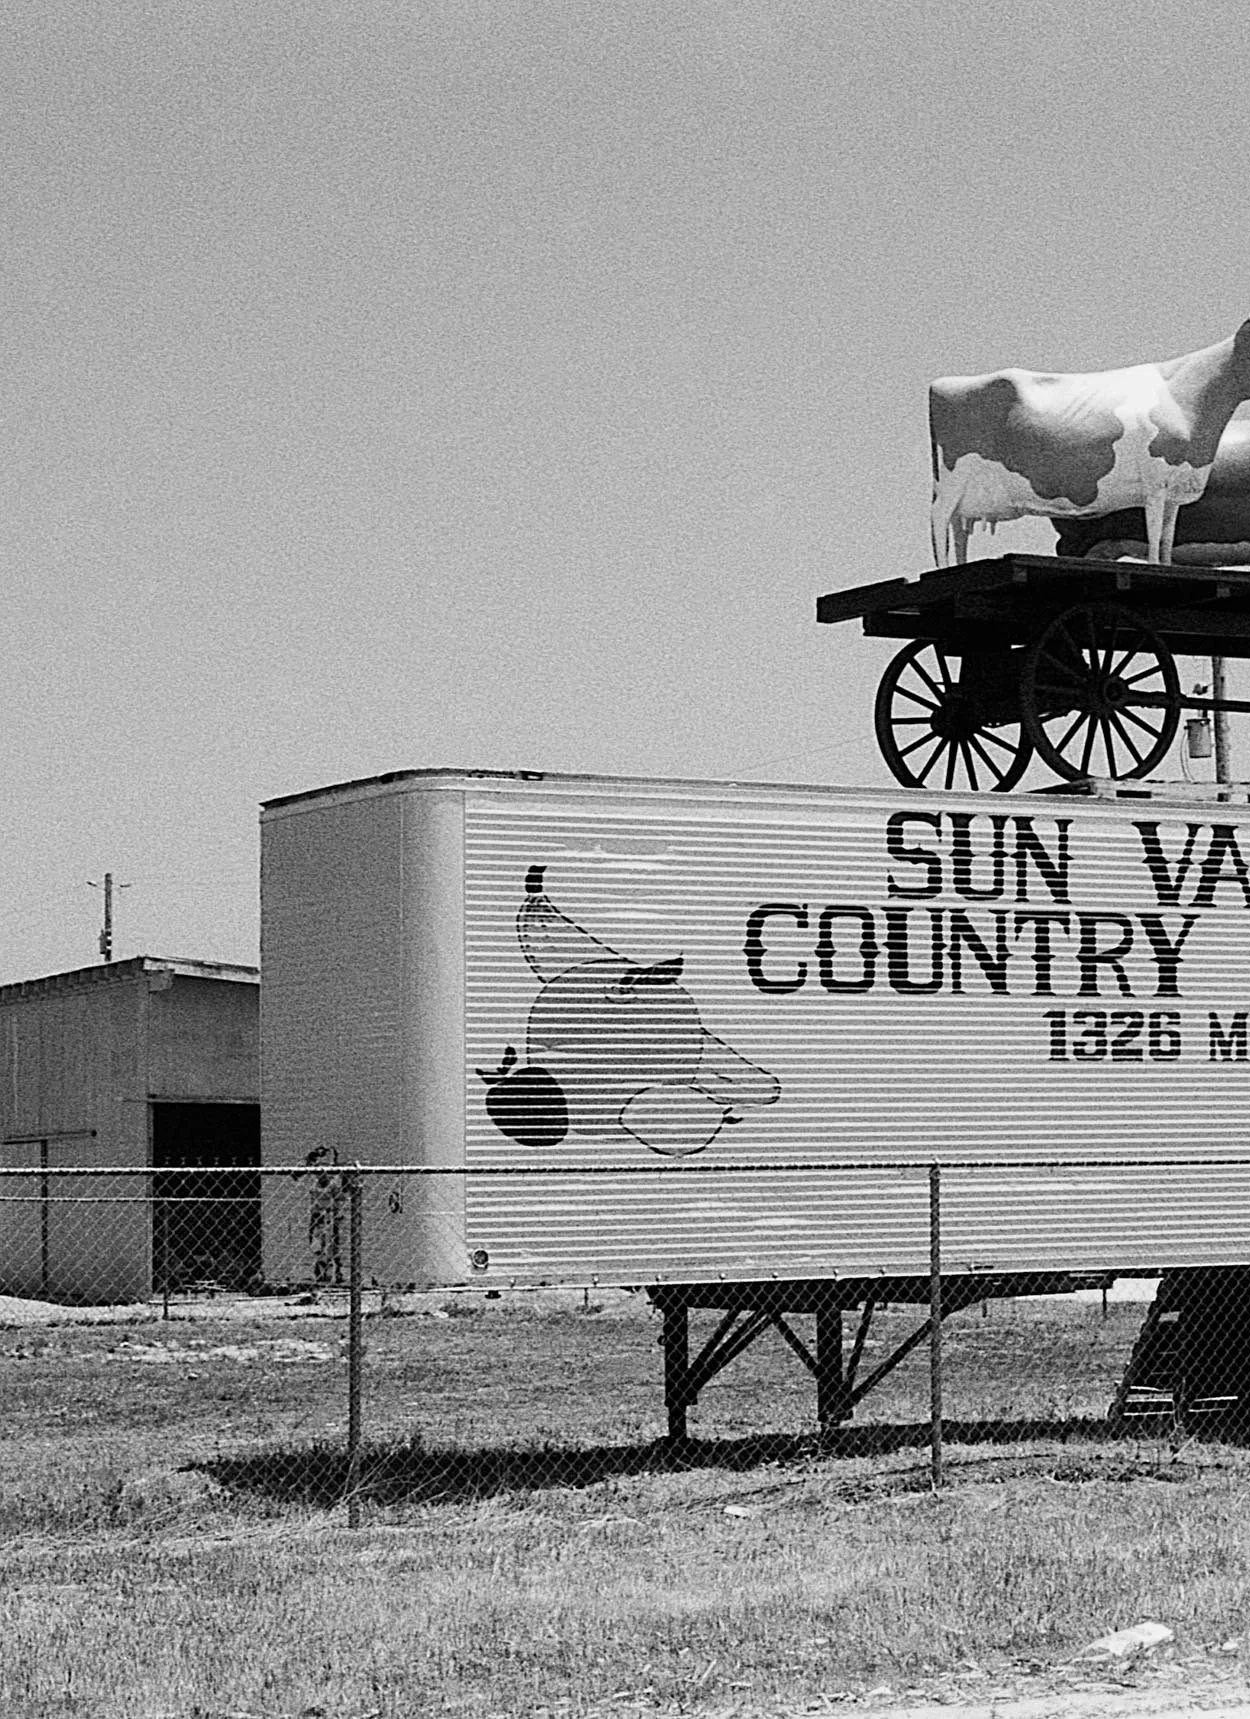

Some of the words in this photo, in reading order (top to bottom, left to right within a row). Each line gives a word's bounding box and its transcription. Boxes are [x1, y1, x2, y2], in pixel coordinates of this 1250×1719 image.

[886, 811, 1074, 904] SUN
[741, 903, 1201, 997] COUNTRY
[1042, 1011, 1181, 1062] 1326
